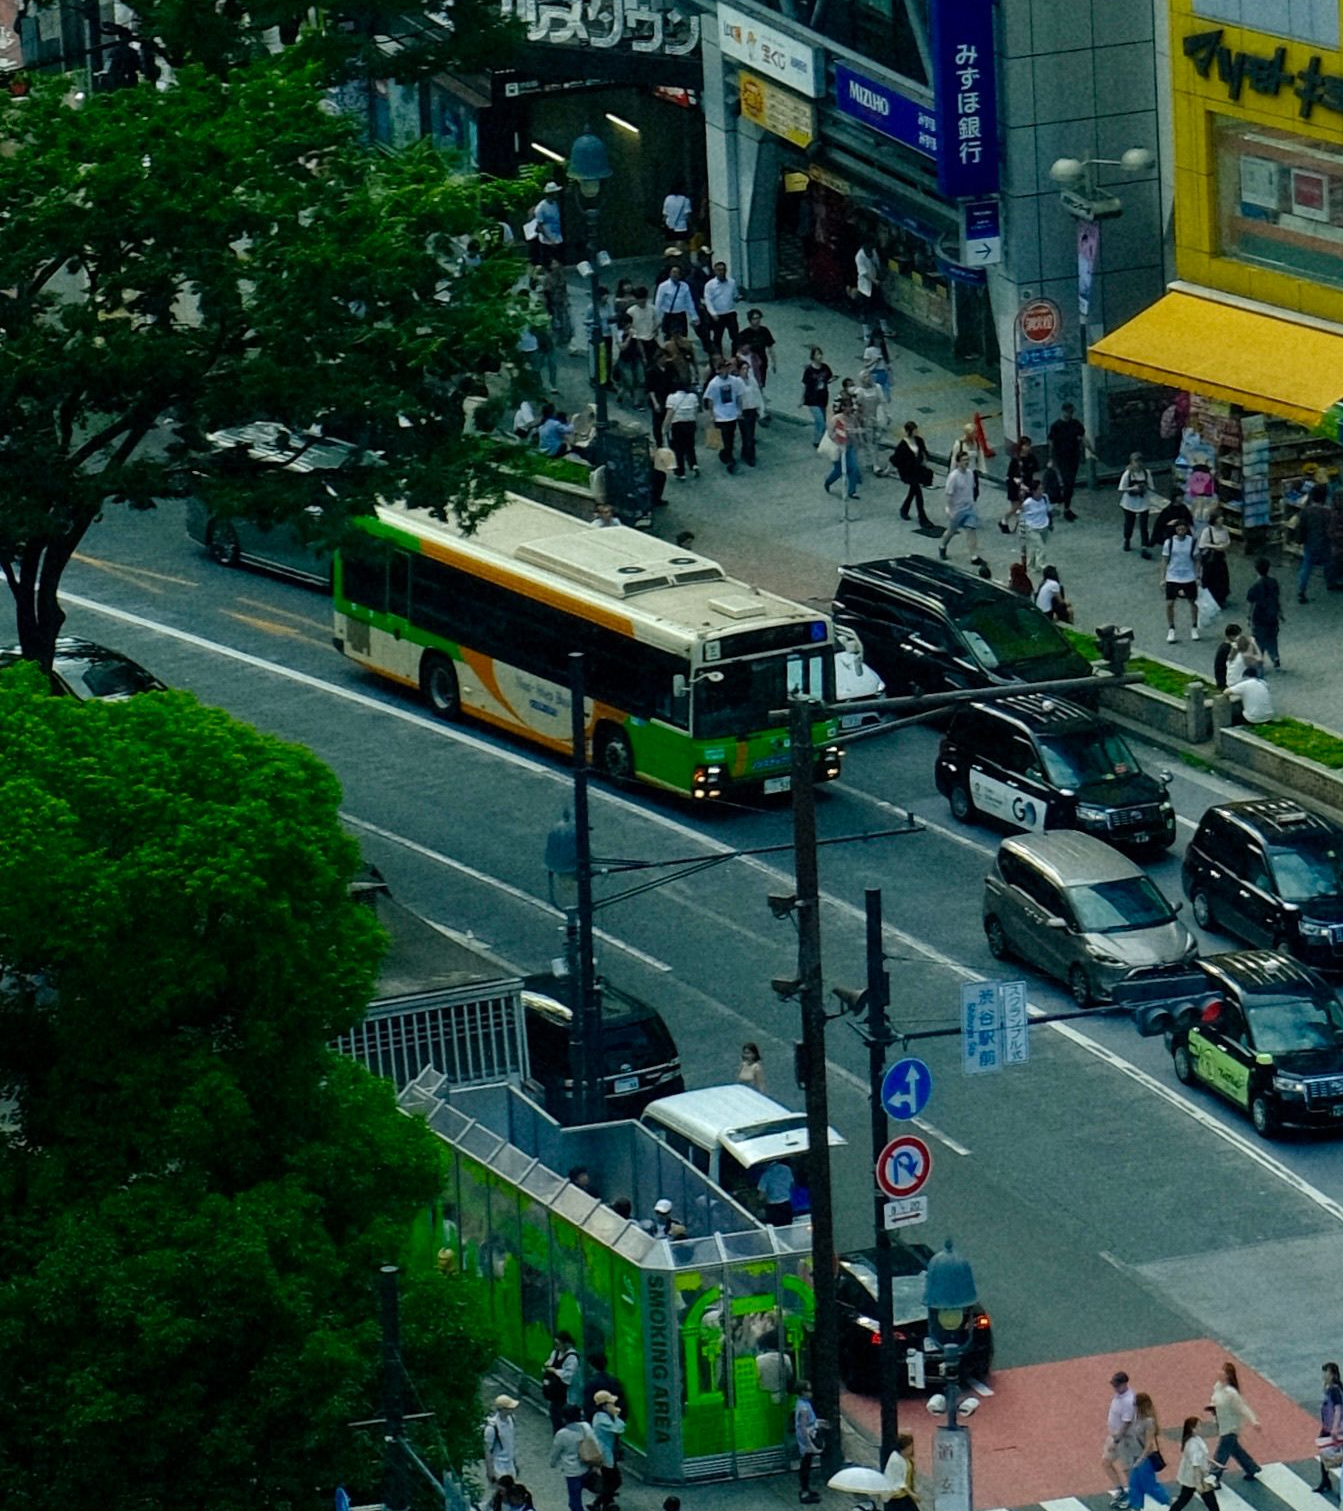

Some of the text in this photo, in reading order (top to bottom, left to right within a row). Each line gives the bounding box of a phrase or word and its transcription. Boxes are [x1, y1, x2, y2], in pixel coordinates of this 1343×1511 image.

[848, 80, 890, 116] MIZUHO
[954, 44, 984, 165] みずほ銀行
[1012, 796, 1038, 828] GO
[978, 988, 996, 1067] 渋谷駅前
[1009, 986, 1023, 1060] スクランブル式
